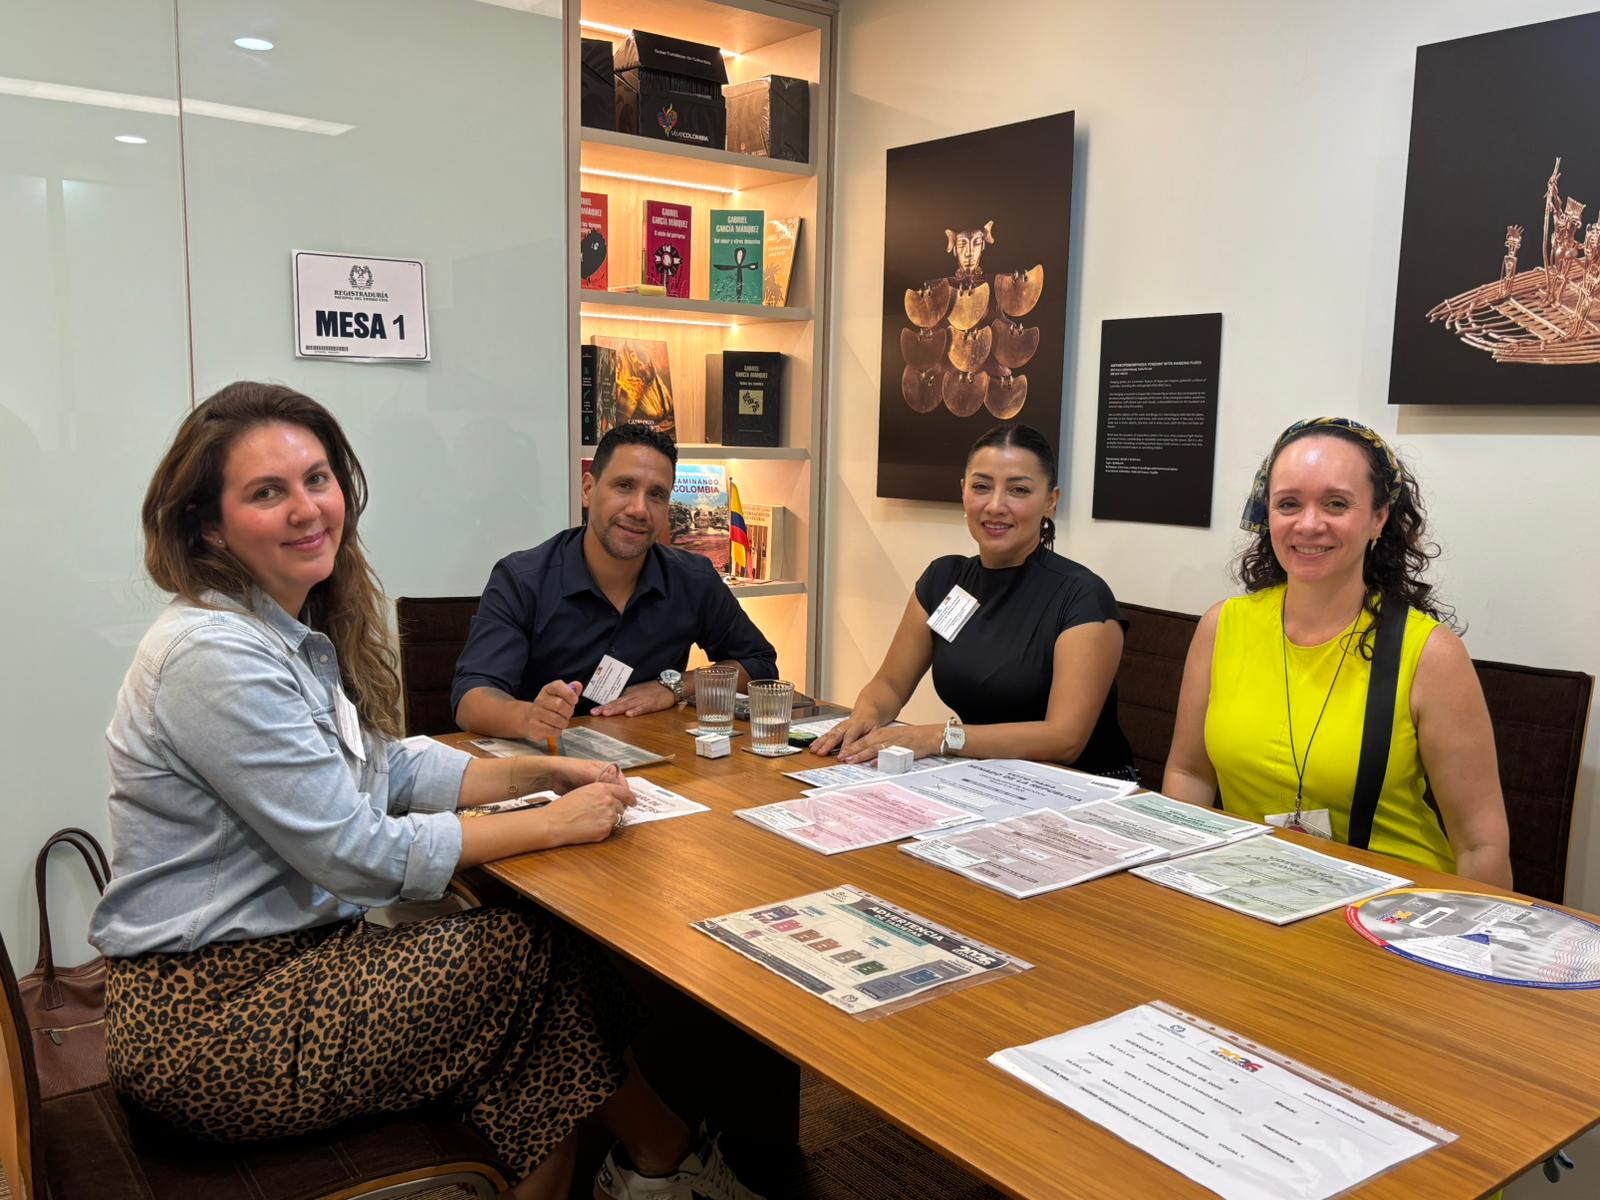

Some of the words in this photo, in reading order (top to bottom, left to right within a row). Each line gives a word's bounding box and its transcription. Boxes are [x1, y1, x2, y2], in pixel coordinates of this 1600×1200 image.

[334, 289, 389, 299] REGISTRADURÍA
[315, 309, 387, 340] MESA
[392, 314, 406, 341] 1
[673, 484, 720, 495] COLOMBIA
[676, 478, 720, 486] AMINANDO
[867, 906, 945, 942] ADVERTENCIA
[1261, 1123, 1303, 1146] PRESIDENTE
[1217, 1142, 1240, 1156] VOCAL
[1240, 1132, 1296, 1164] VICEPRESIDENTE
[1194, 1151, 1216, 1166] VOCAL
